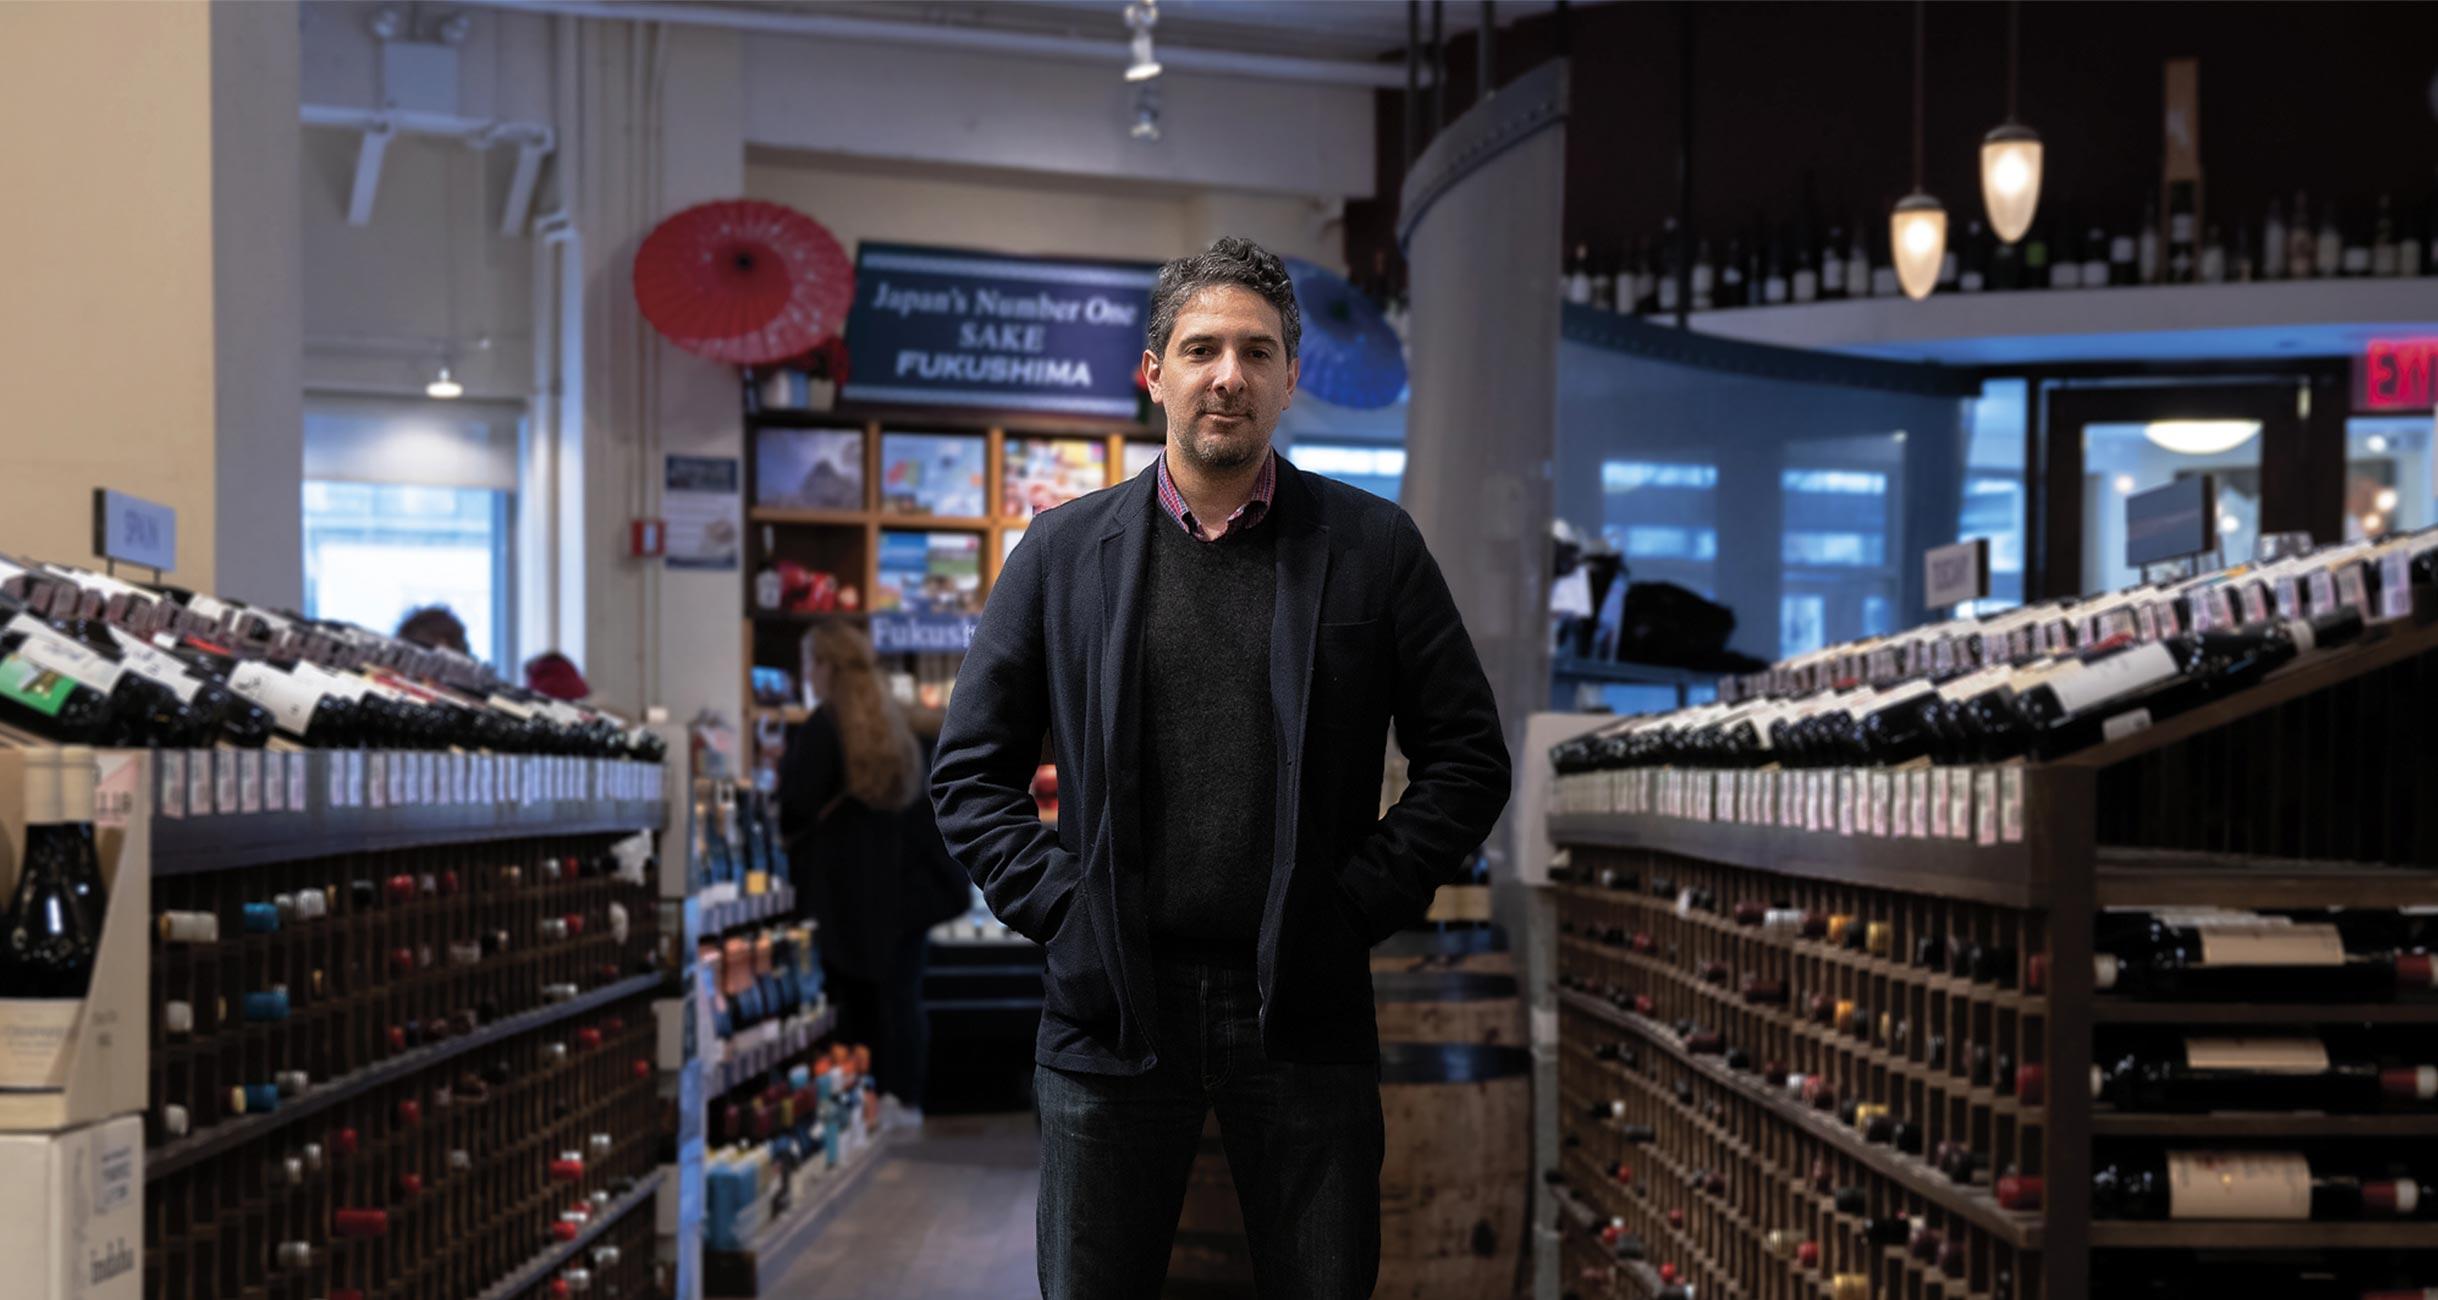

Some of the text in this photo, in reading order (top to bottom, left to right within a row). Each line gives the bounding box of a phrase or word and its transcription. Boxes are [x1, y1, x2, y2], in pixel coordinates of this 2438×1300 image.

[872, 282, 1137, 326] Japan's Number One
[957, 321, 1047, 354] SAKE
[895, 351, 1093, 387] FUKUSHIMA
